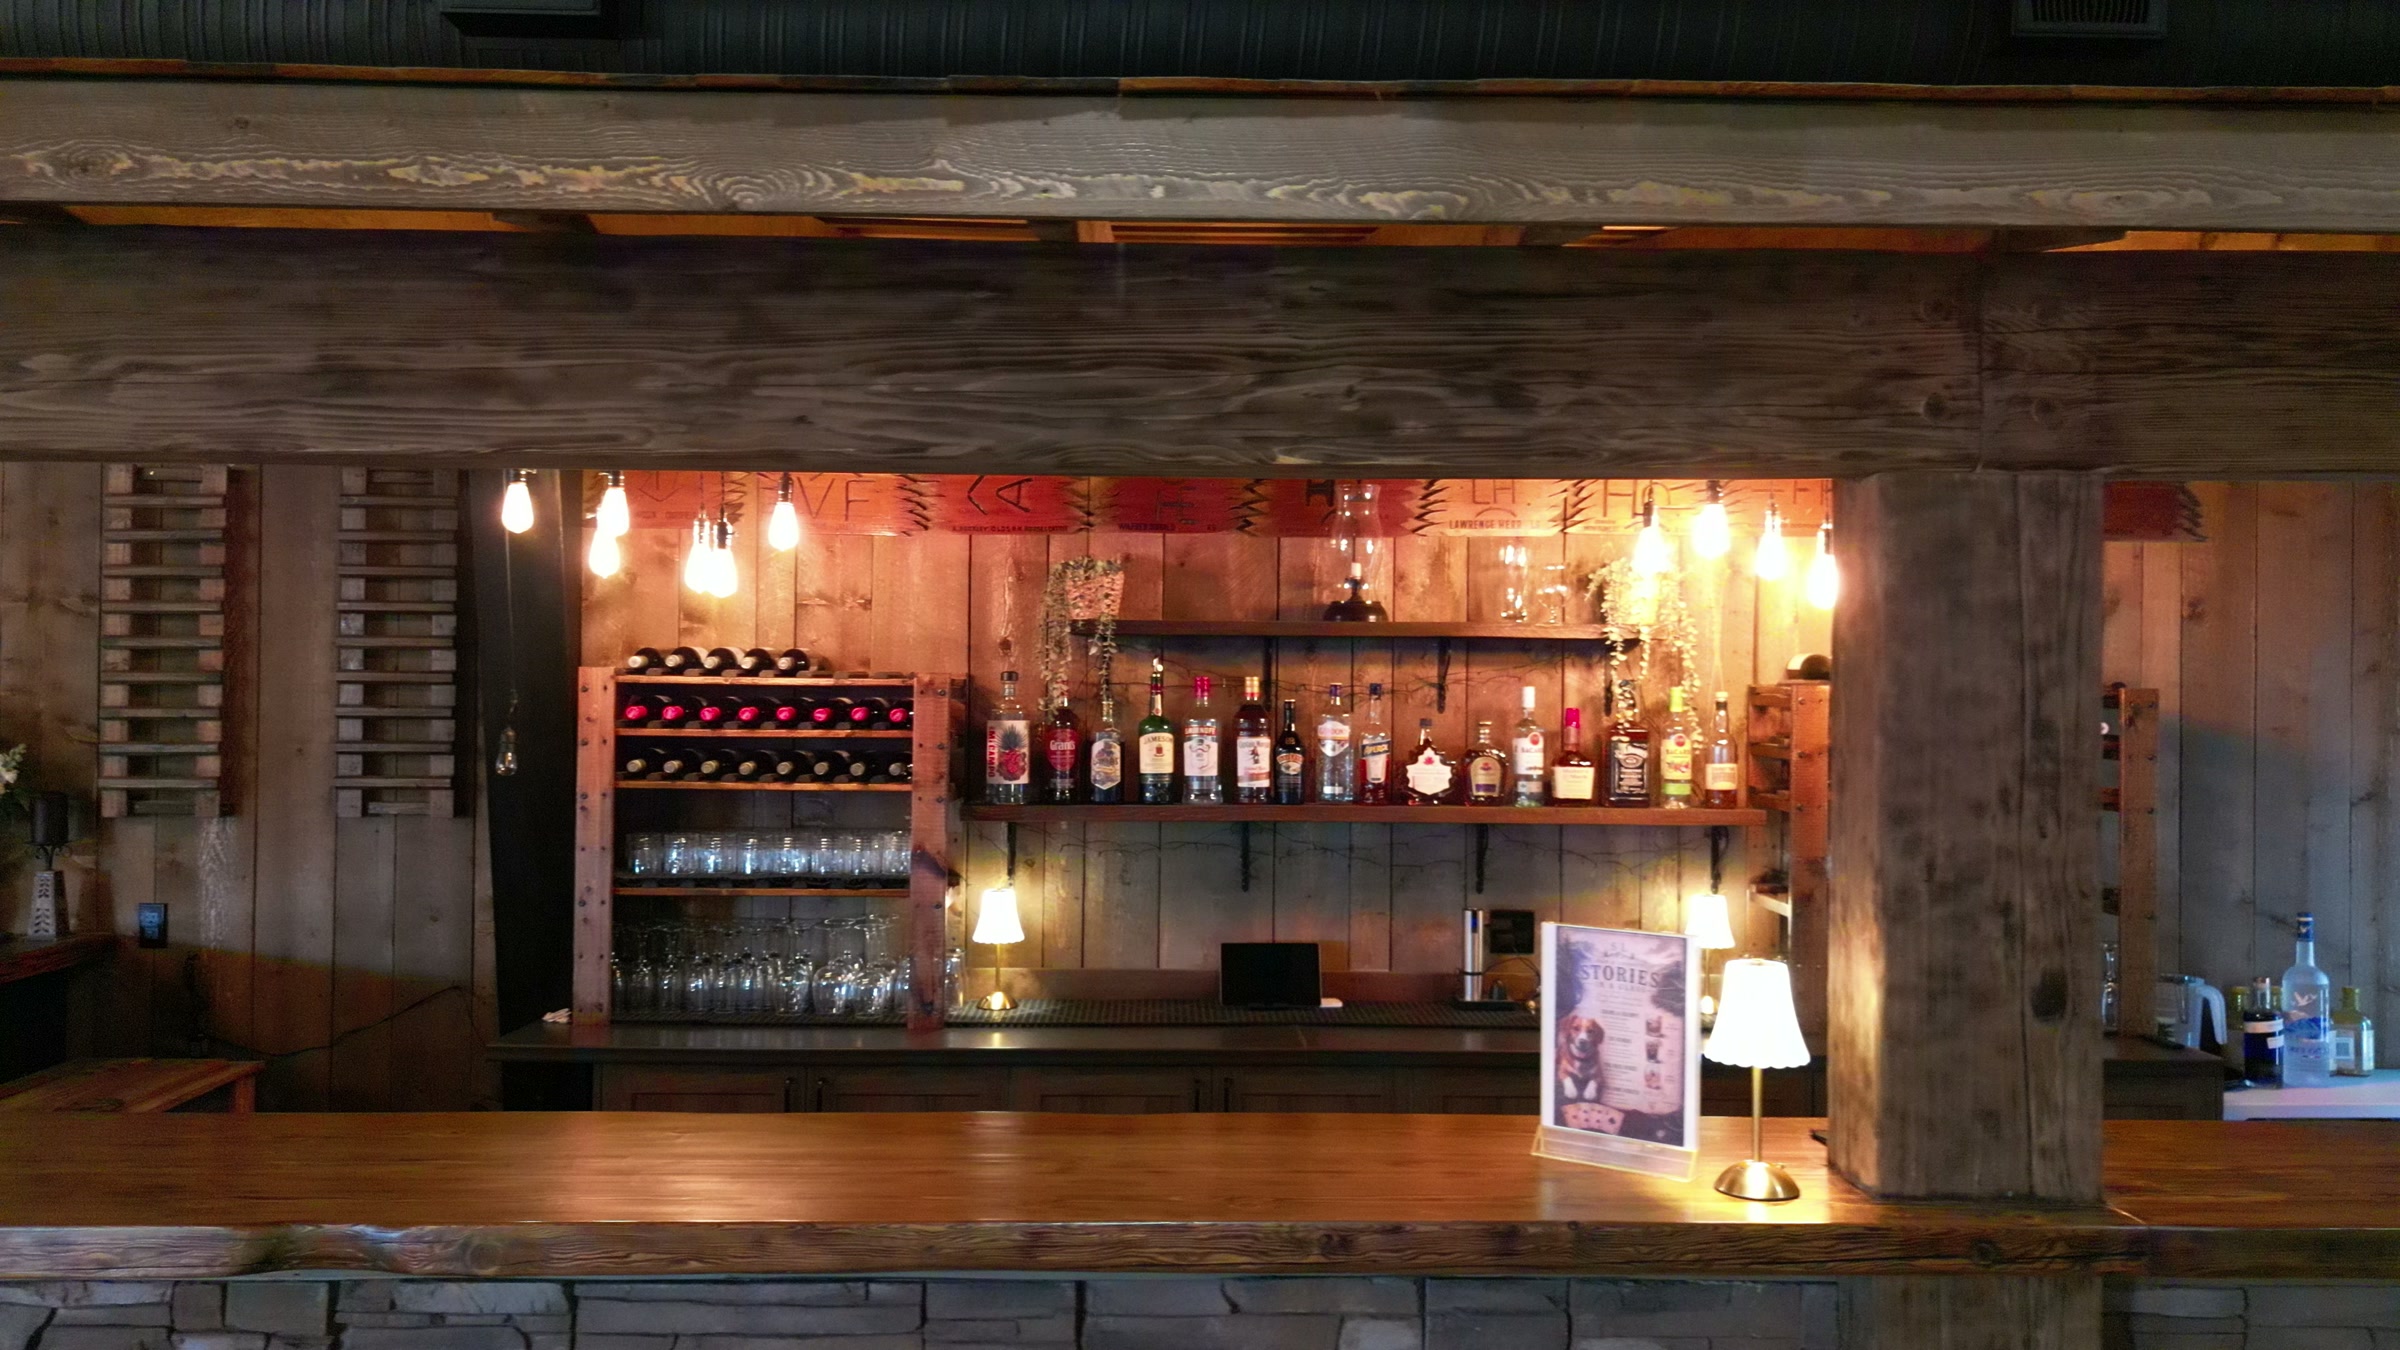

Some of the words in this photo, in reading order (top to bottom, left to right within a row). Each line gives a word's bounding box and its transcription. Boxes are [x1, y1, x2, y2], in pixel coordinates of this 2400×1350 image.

[1449, 519, 1496, 530] LAWRENCE
[1144, 735, 1173, 745] JAMESON
[1580, 964, 1660, 988] STORIES
